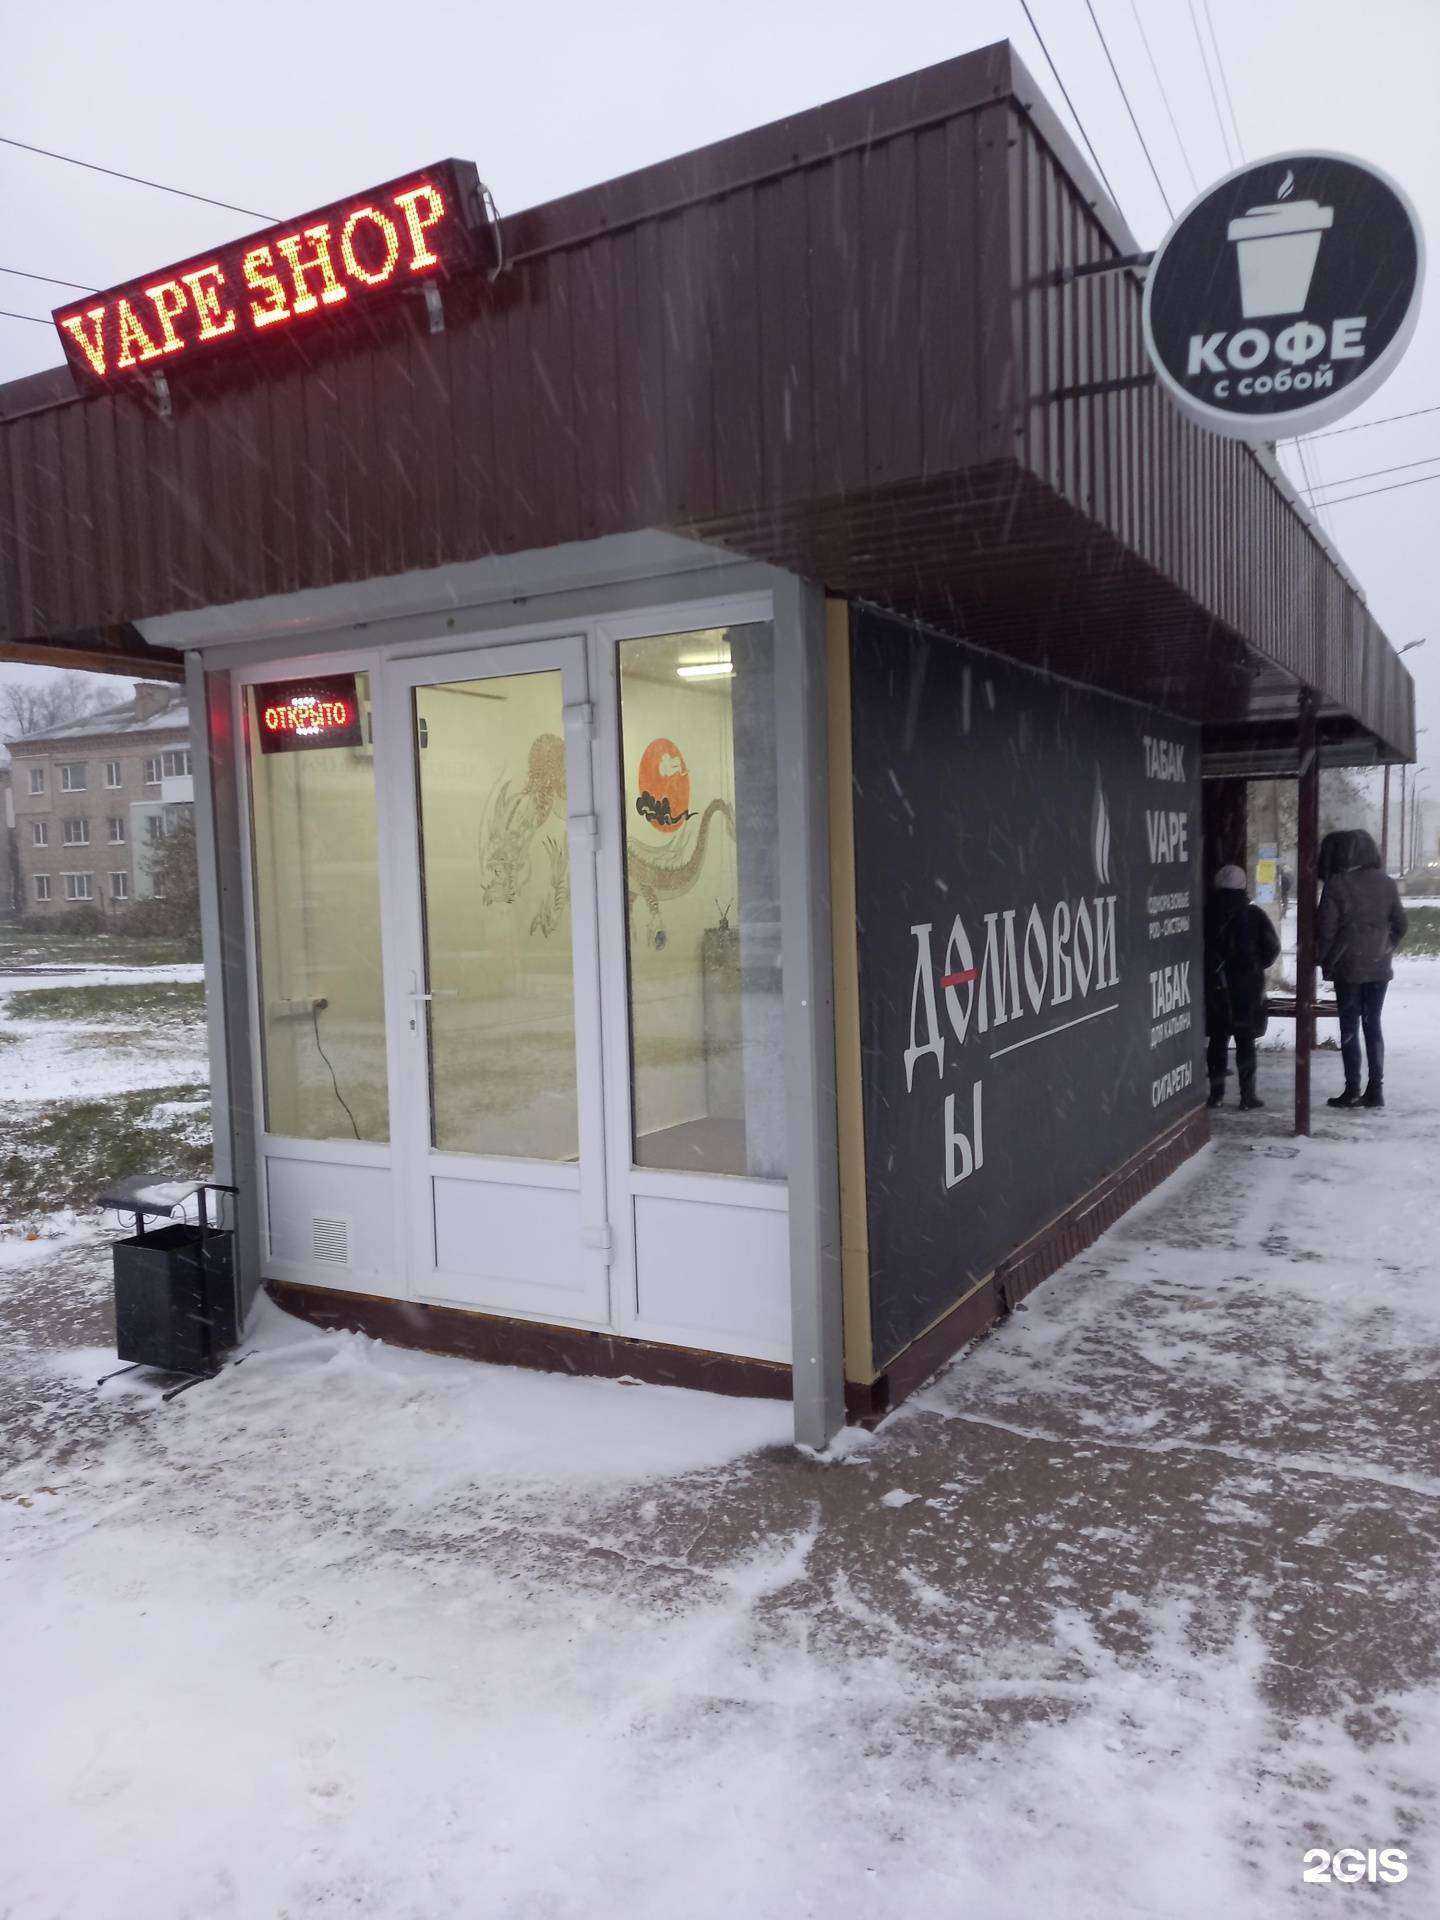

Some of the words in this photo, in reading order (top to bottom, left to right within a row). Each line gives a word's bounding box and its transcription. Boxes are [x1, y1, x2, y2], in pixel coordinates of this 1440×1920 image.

[62, 264, 236, 376] VAPE
[242, 184, 444, 328] SHOP
[1187, 316, 1367, 375] КОФЕ
[1214, 378, 1229, 398] с
[1237, 363, 1334, 396] собой
[265, 702, 346, 730] ОТКРЫТО
[1142, 735, 1186, 783] ТАБАК
[1146, 809, 1188, 864] VAPE
[1149, 960, 1191, 1019] ТАБАК
[1152, 1060, 1192, 1108] СИГАРЕТЫ
[944, 1079, 984, 1190] Ы
